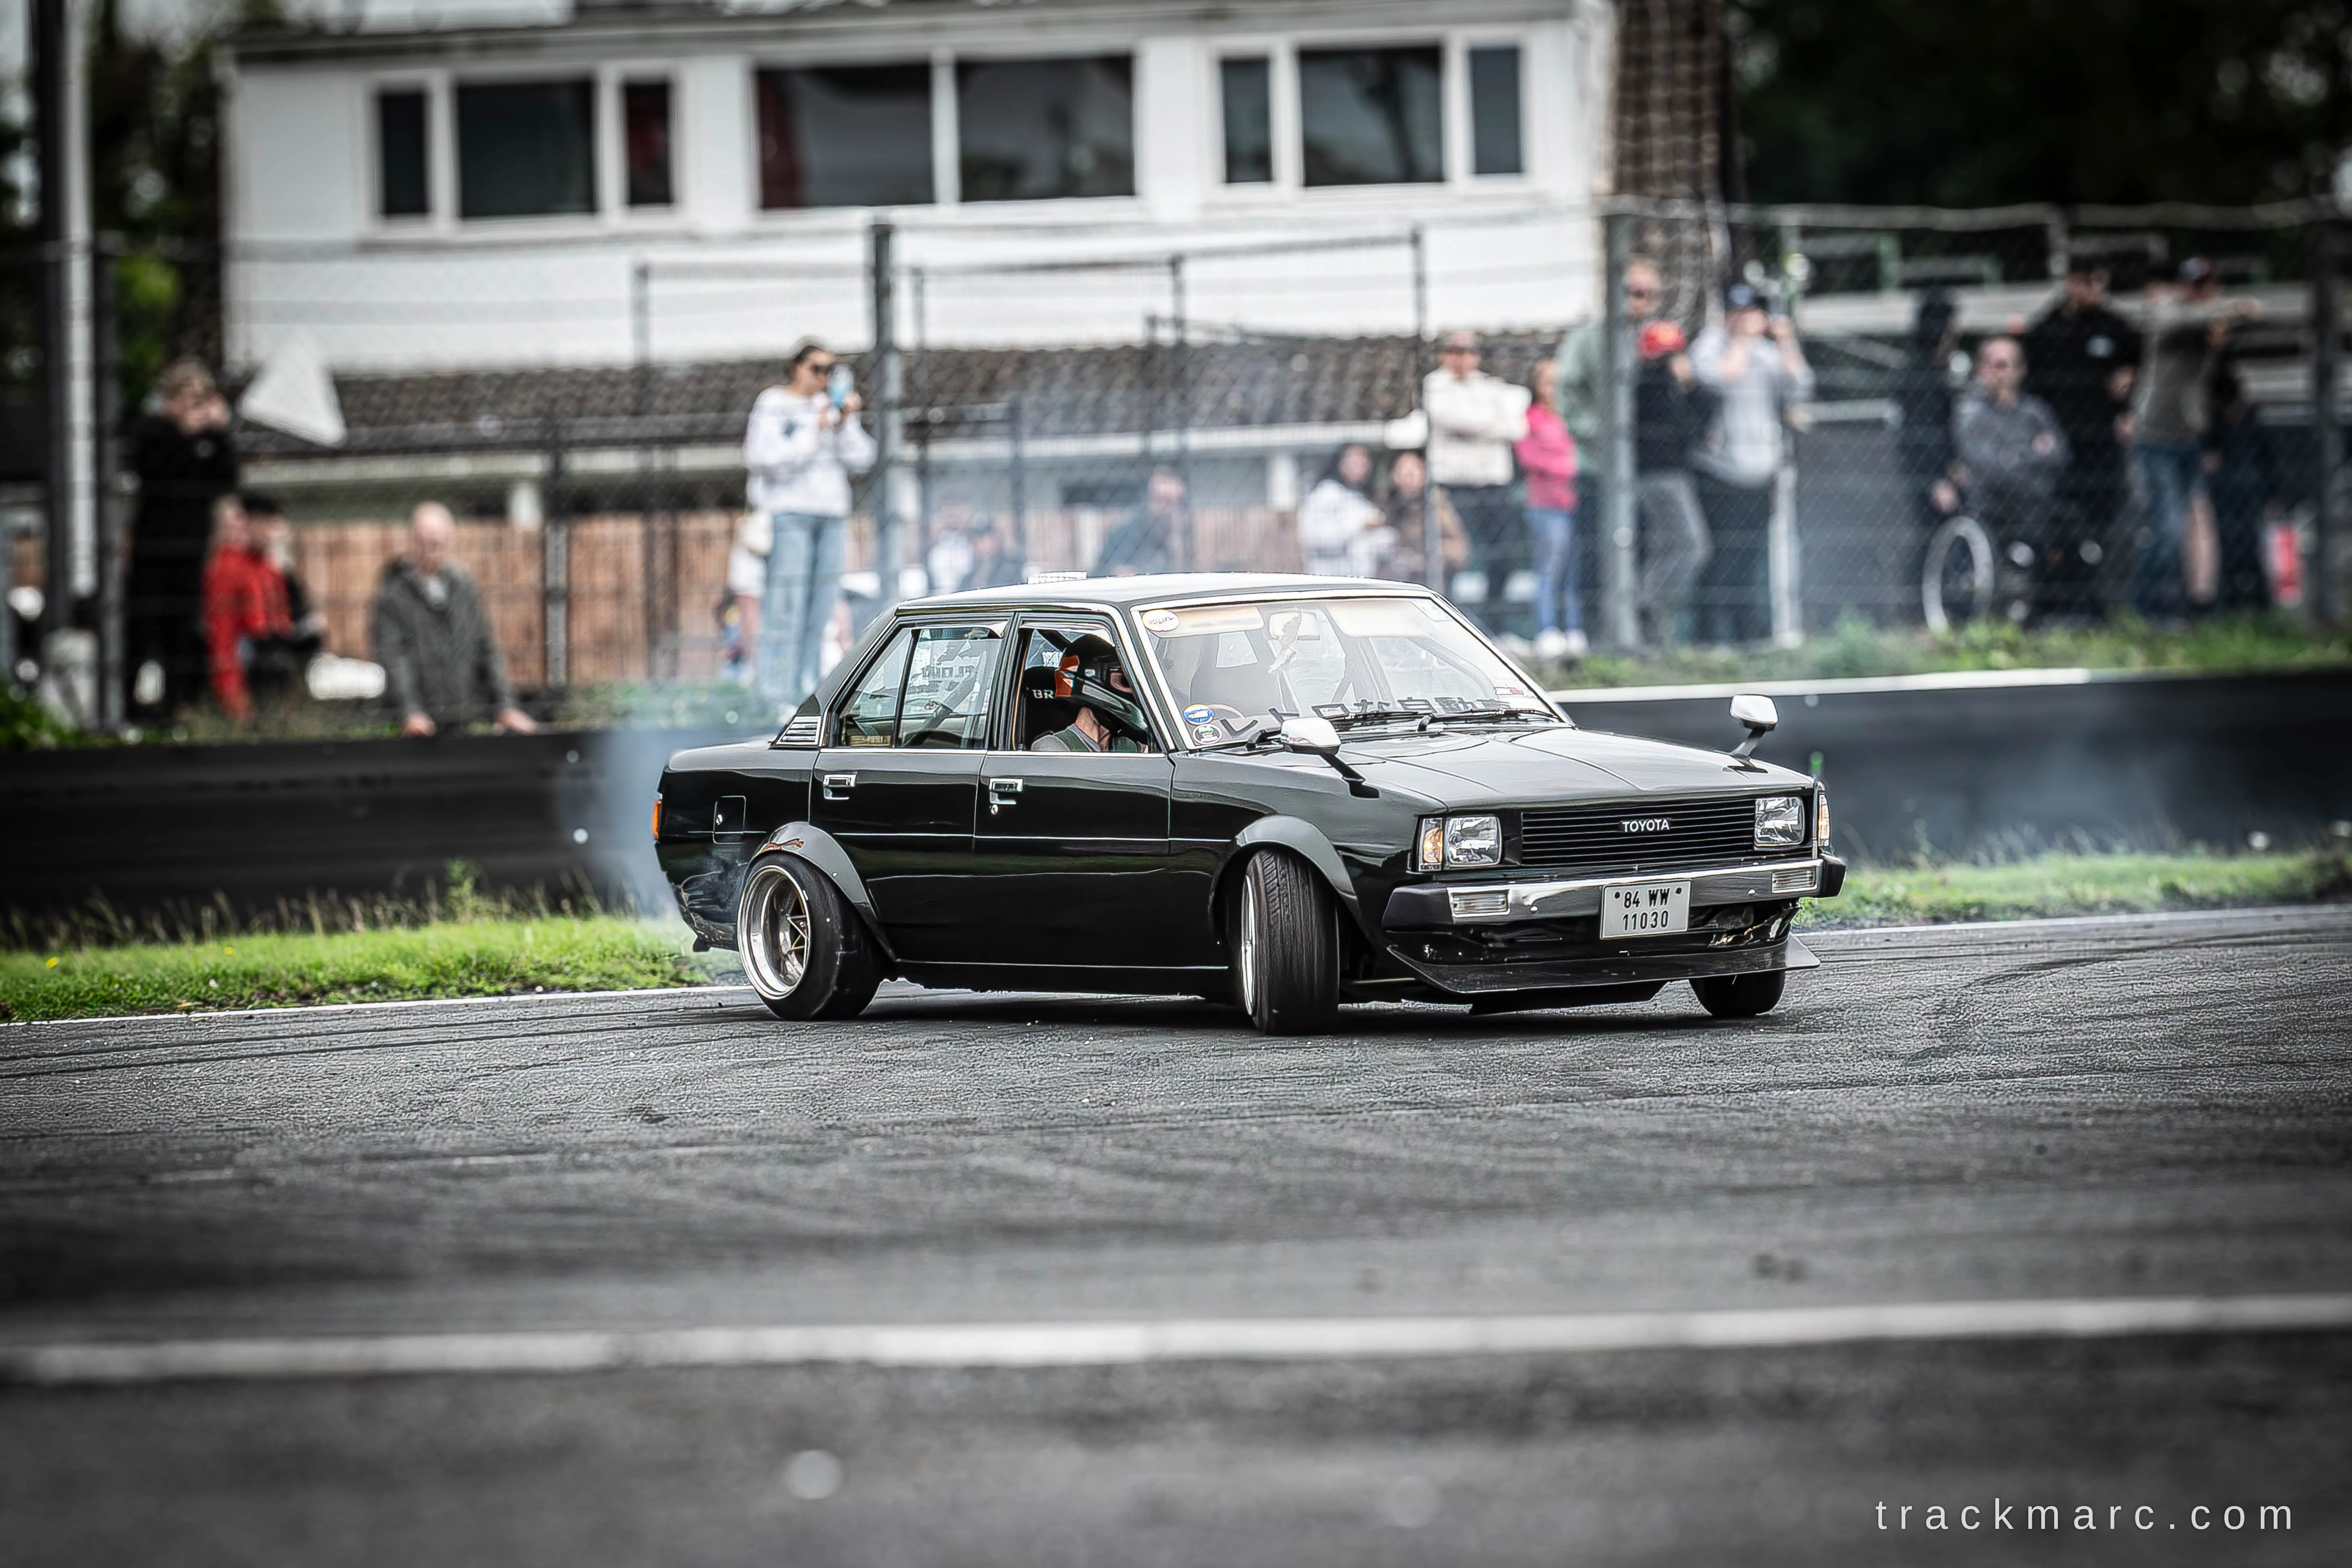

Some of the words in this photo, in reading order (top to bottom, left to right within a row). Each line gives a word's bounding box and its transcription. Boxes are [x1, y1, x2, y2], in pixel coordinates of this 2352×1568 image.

[1032, 689, 1054, 699] BR
[1622, 819, 1670, 833] TOYOTA
[1624, 890, 1640, 909] 84
[1648, 888, 1670, 907] WW
[1622, 910, 1669, 931] 11030
